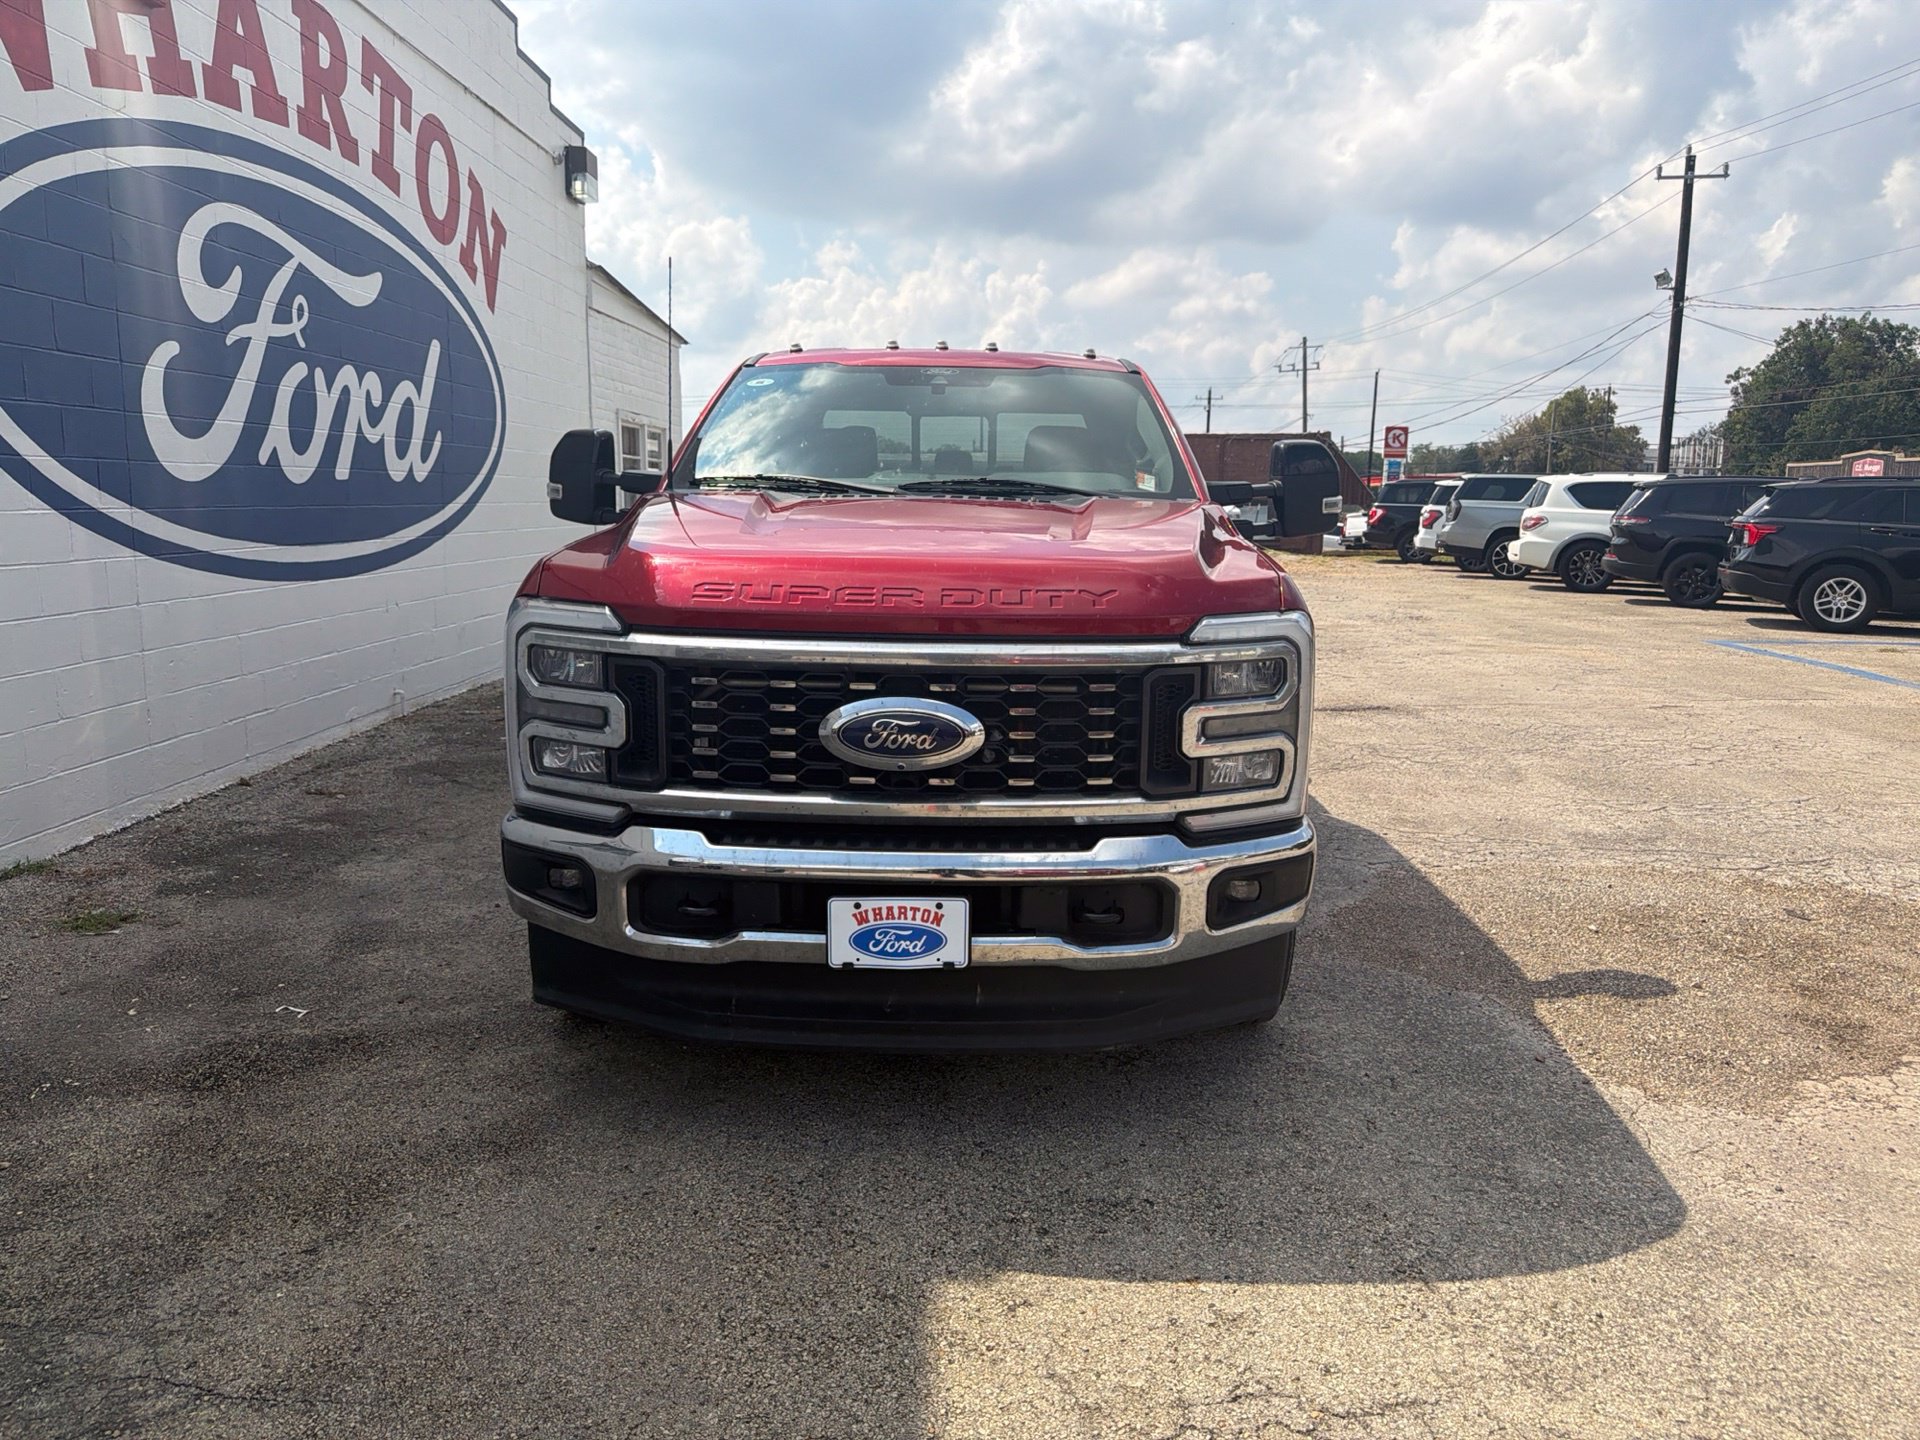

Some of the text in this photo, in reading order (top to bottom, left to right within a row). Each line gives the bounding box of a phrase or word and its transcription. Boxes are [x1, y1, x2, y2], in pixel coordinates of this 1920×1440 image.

[0, 0, 507, 315] HARTON
[141, 202, 442, 484] Ford
[1392, 432, 1405, 447] K
[692, 582, 1118, 608] SUPER DUTY
[864, 718, 939, 750] Ford
[852, 905, 945, 927] WHARTON
[869, 928, 927, 953] Ford
